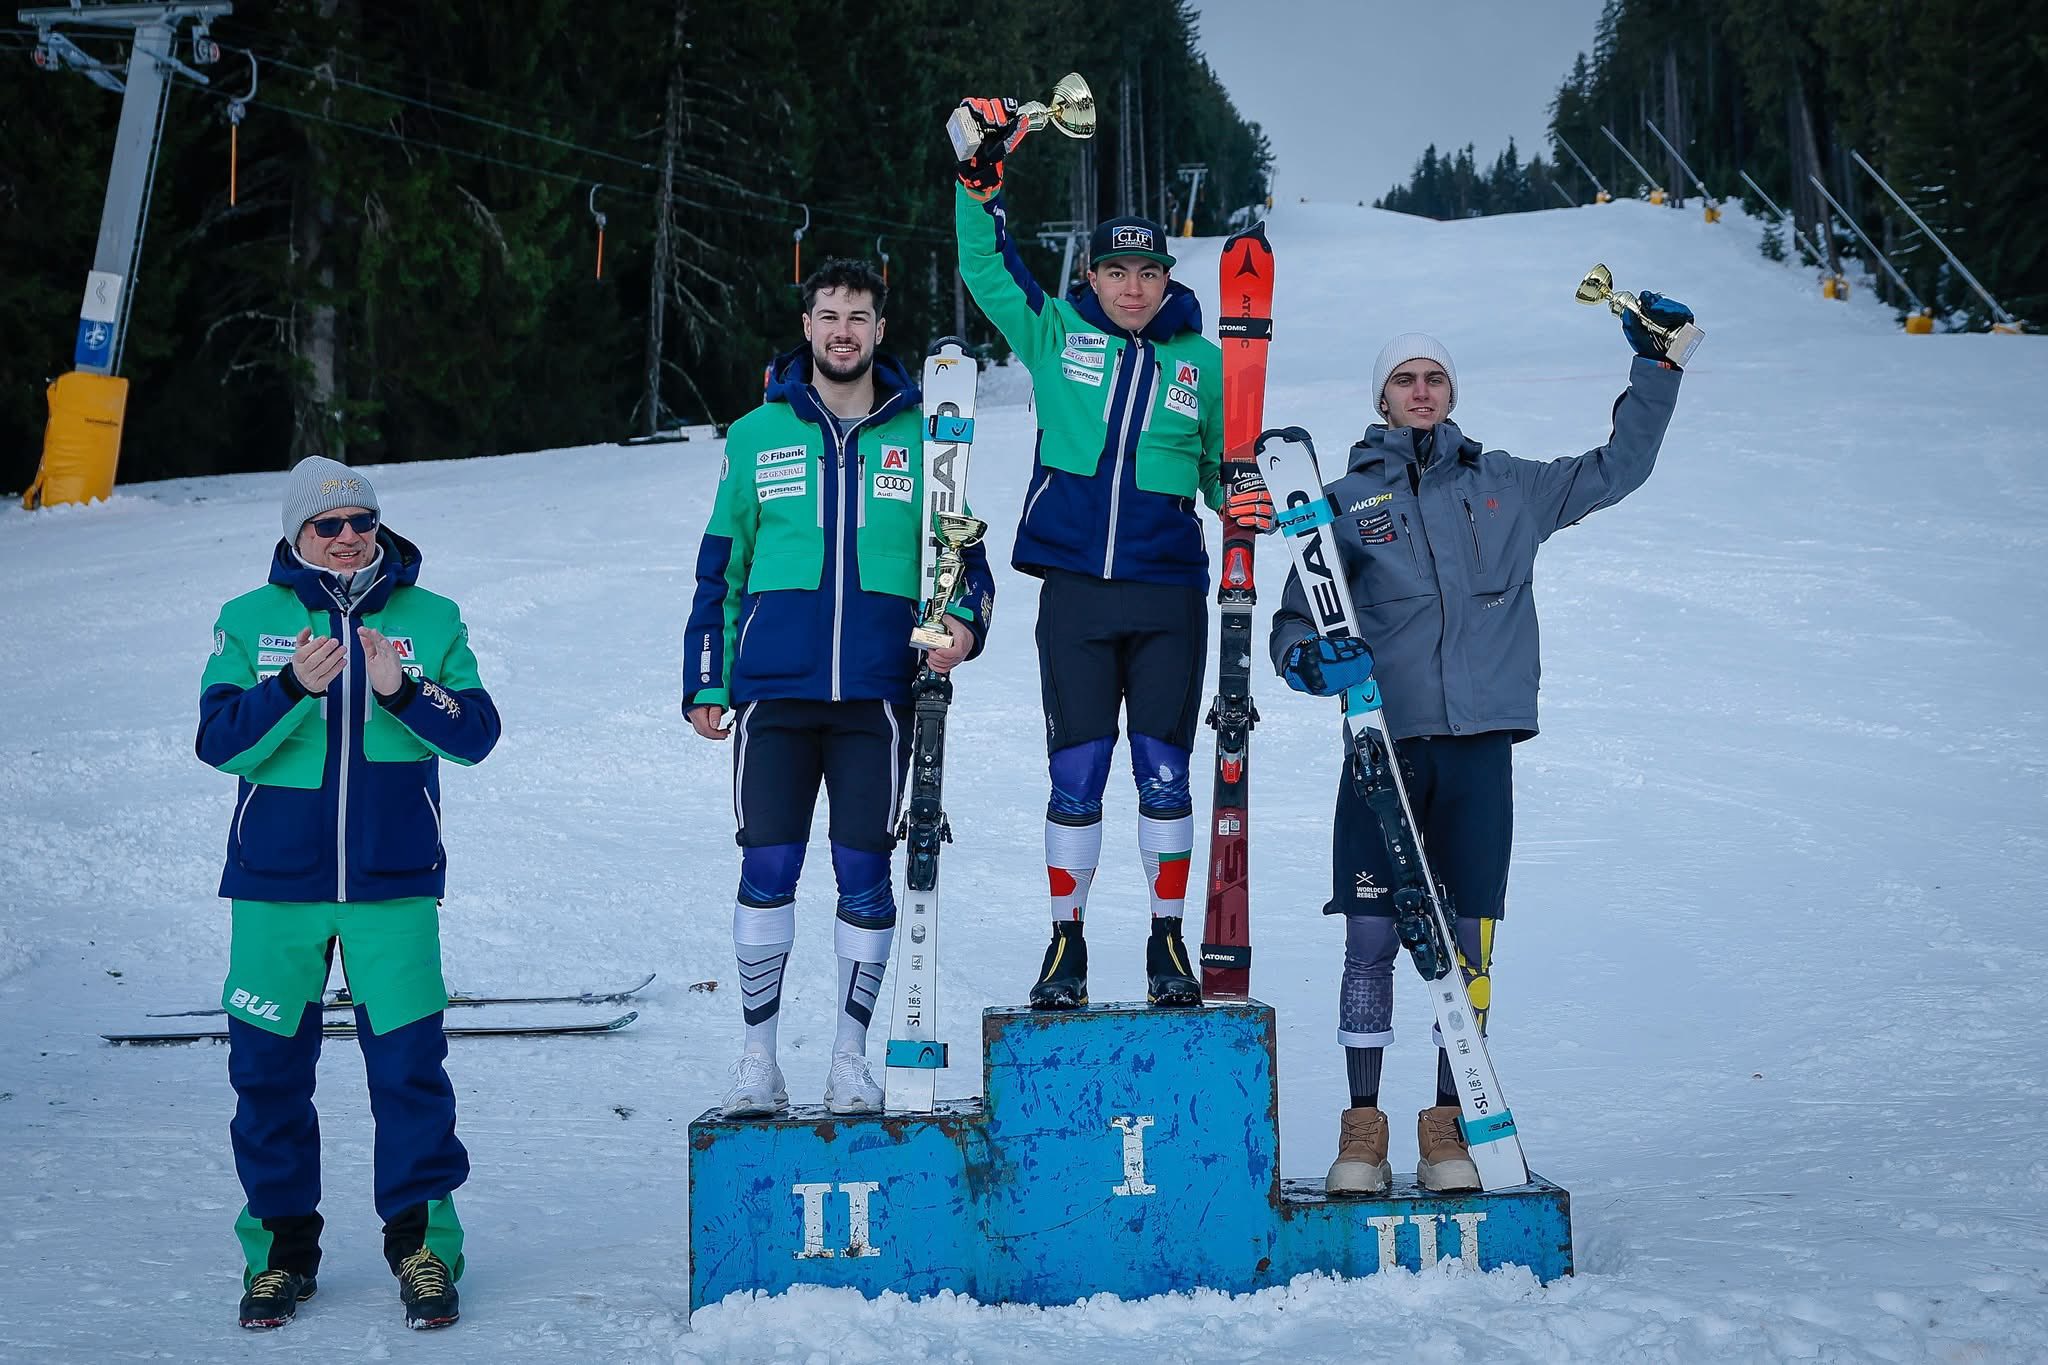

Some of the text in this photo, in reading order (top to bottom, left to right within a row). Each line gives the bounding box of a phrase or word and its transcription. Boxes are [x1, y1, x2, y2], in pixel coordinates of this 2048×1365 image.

[1118, 232, 1148, 242] CLIF
[1078, 336, 1106, 346] Fibank
[1075, 354, 1103, 364] GENERALI
[1178, 366, 1198, 386] A1
[1166, 402, 1182, 412] Audi
[770, 448, 804, 460] Fibank
[883, 450, 908, 468] A1
[768, 467, 804, 478] GENERALI
[274, 638, 296, 648] Fiba
[393, 638, 412, 658] A1
[1204, 954, 1235, 962] ATOMIC
[229, 988, 282, 1022] BUL
[1468, 1079, 1482, 1088] 165
[1110, 1116, 1157, 1197] I
[792, 1181, 880, 1260] II
[1367, 1212, 1488, 1271] III
